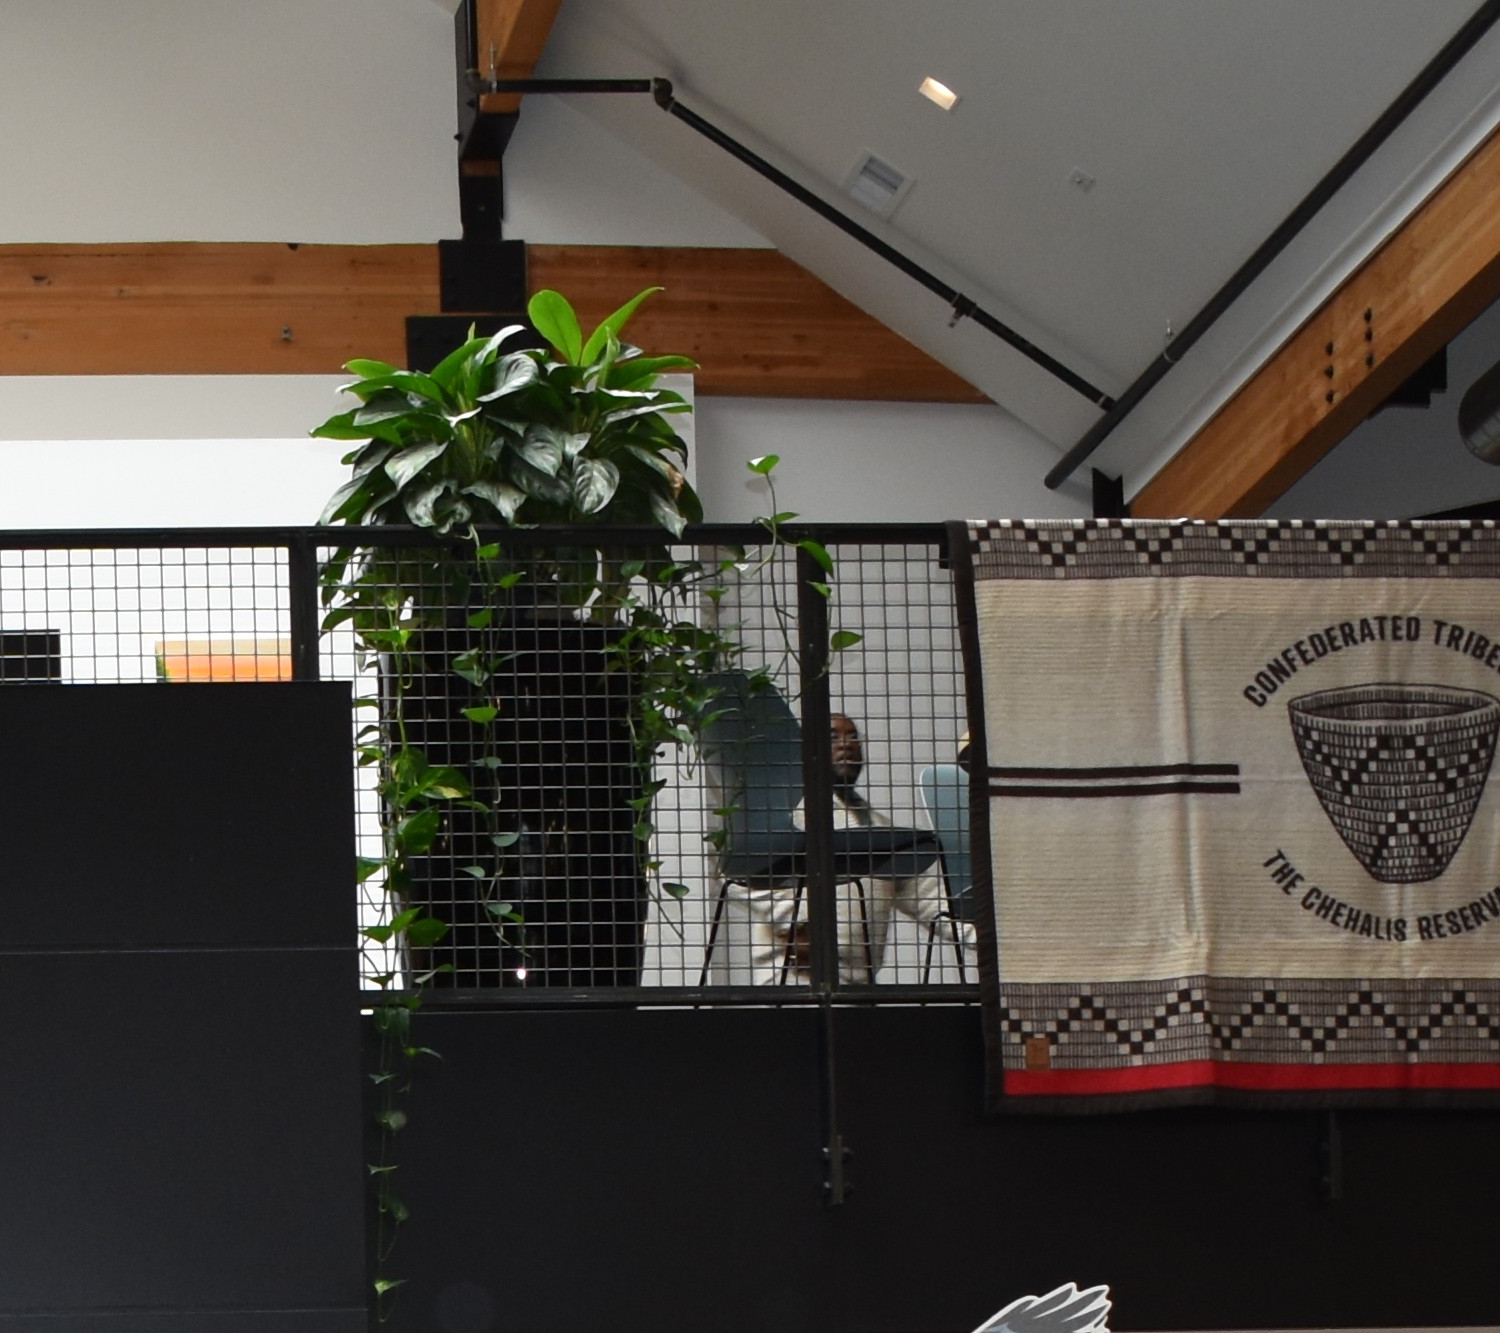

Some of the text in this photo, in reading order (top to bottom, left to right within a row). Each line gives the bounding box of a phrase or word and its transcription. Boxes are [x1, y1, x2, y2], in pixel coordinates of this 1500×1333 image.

[1243, 615, 1421, 708] CONFEDERATED
[1262, 848, 1305, 896] THE
[1300, 885, 1408, 942] CHEHALIS
